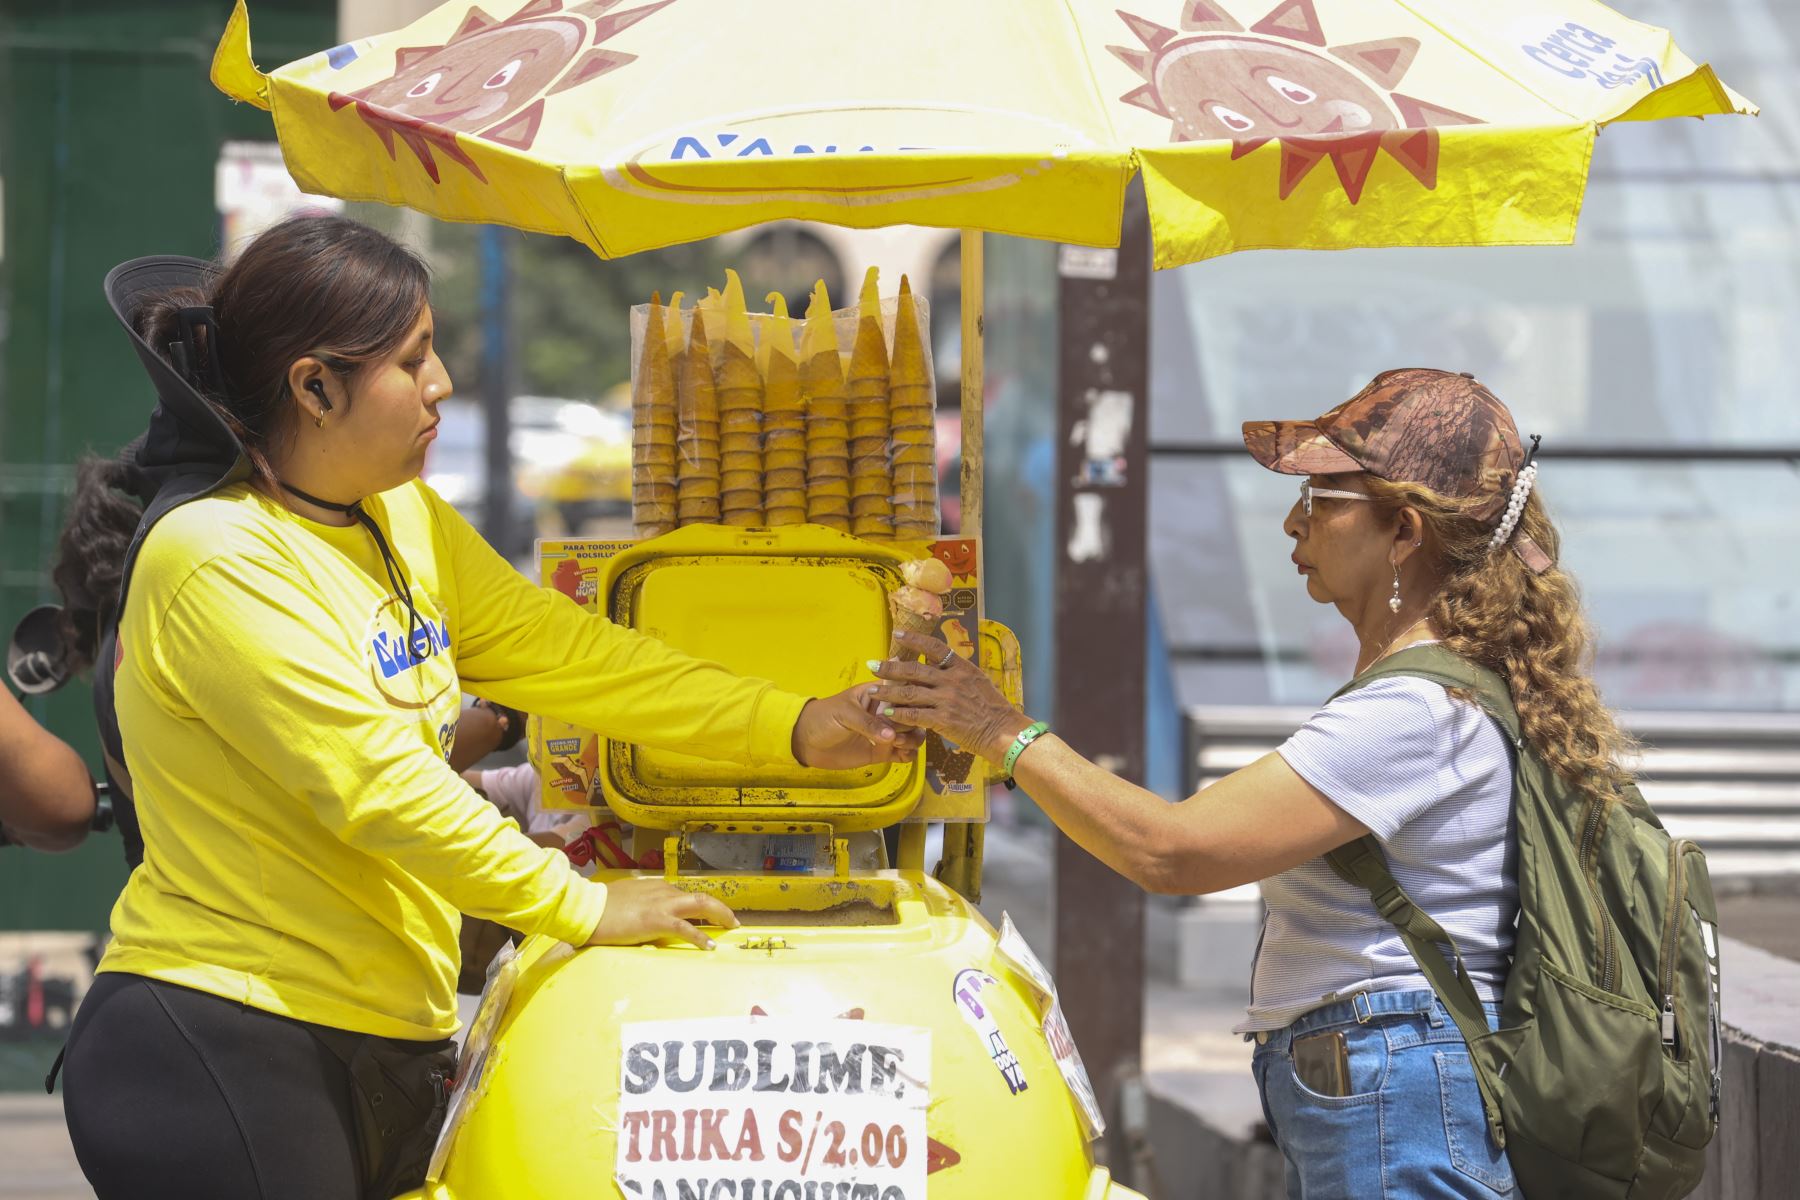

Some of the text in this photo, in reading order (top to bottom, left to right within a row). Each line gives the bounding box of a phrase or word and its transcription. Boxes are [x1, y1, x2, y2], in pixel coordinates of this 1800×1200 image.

[1521, 22, 1616, 79] Cerca
[575, 587, 597, 598] HUM
[624, 1039, 905, 1099] SUBLIME
[623, 1107, 907, 1176] TRIKA S/2.00
